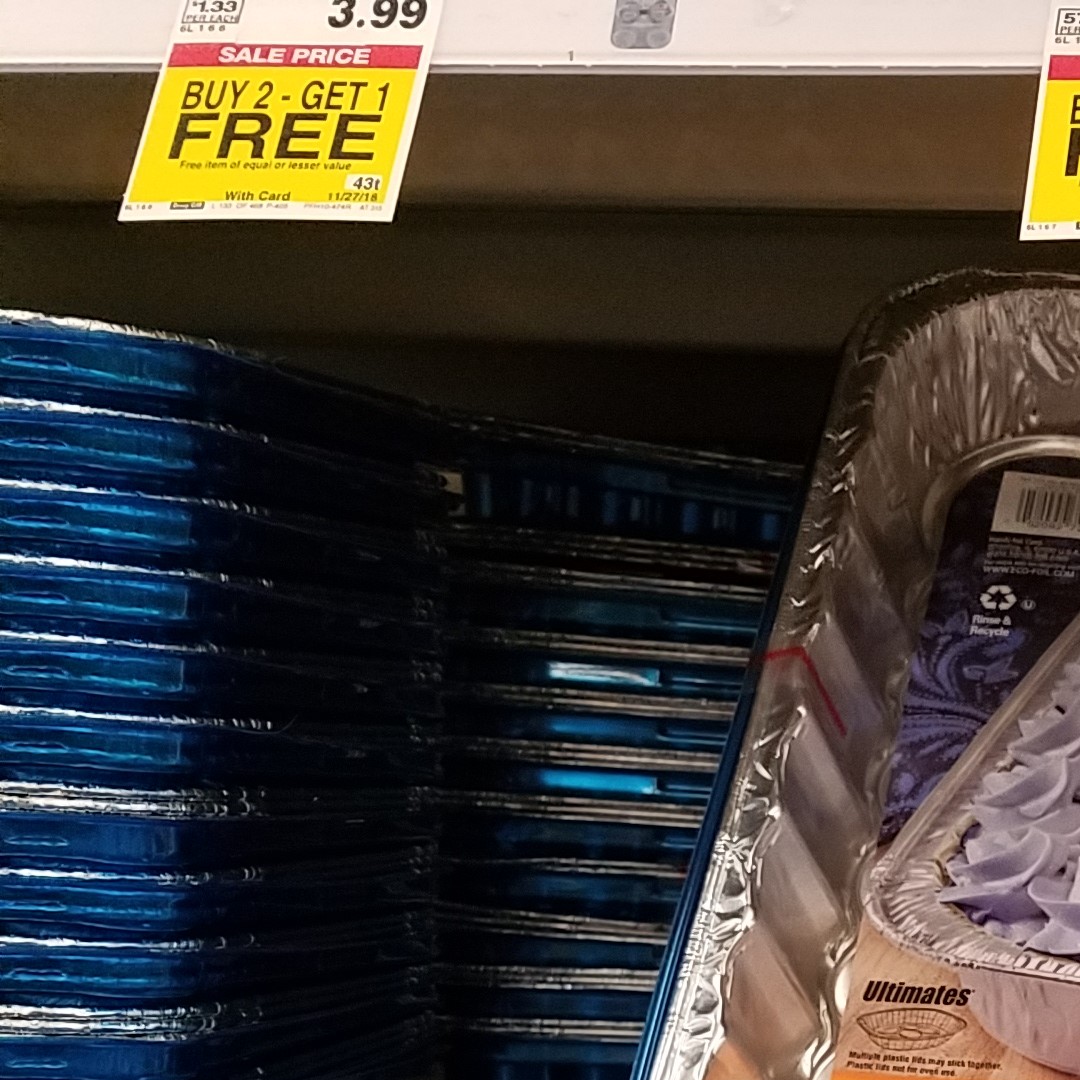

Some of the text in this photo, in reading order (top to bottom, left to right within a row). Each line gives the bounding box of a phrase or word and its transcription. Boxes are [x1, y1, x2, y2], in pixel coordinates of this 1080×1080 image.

[328, 0, 427, 29] 3.99
[218, 47, 371, 65] SALE PRICE
[181, 81, 390, 111] BUY 2 GET 1
[168, 112, 383, 160] FREE
[353, 177, 380, 190] 43t
[225, 191, 291, 201] With Card
[327, 192, 378, 202] 11/27/18
[972, 614, 1001, 626] Rinse
[969, 625, 1010, 637] Recycle
[862, 980, 971, 1006] Ultimates
[849, 1051, 880, 1061] Multiple
[883, 1053, 909, 1064] plastic
[911, 1054, 926, 1064] lids
[928, 1057, 945, 1067] may
[947, 1057, 965, 1067] stick
[847, 1061, 872, 1070] Plastic
[876, 1062, 890, 1071] lids
[892, 1064, 905, 1073] not
[907, 1064, 917, 1073] for
